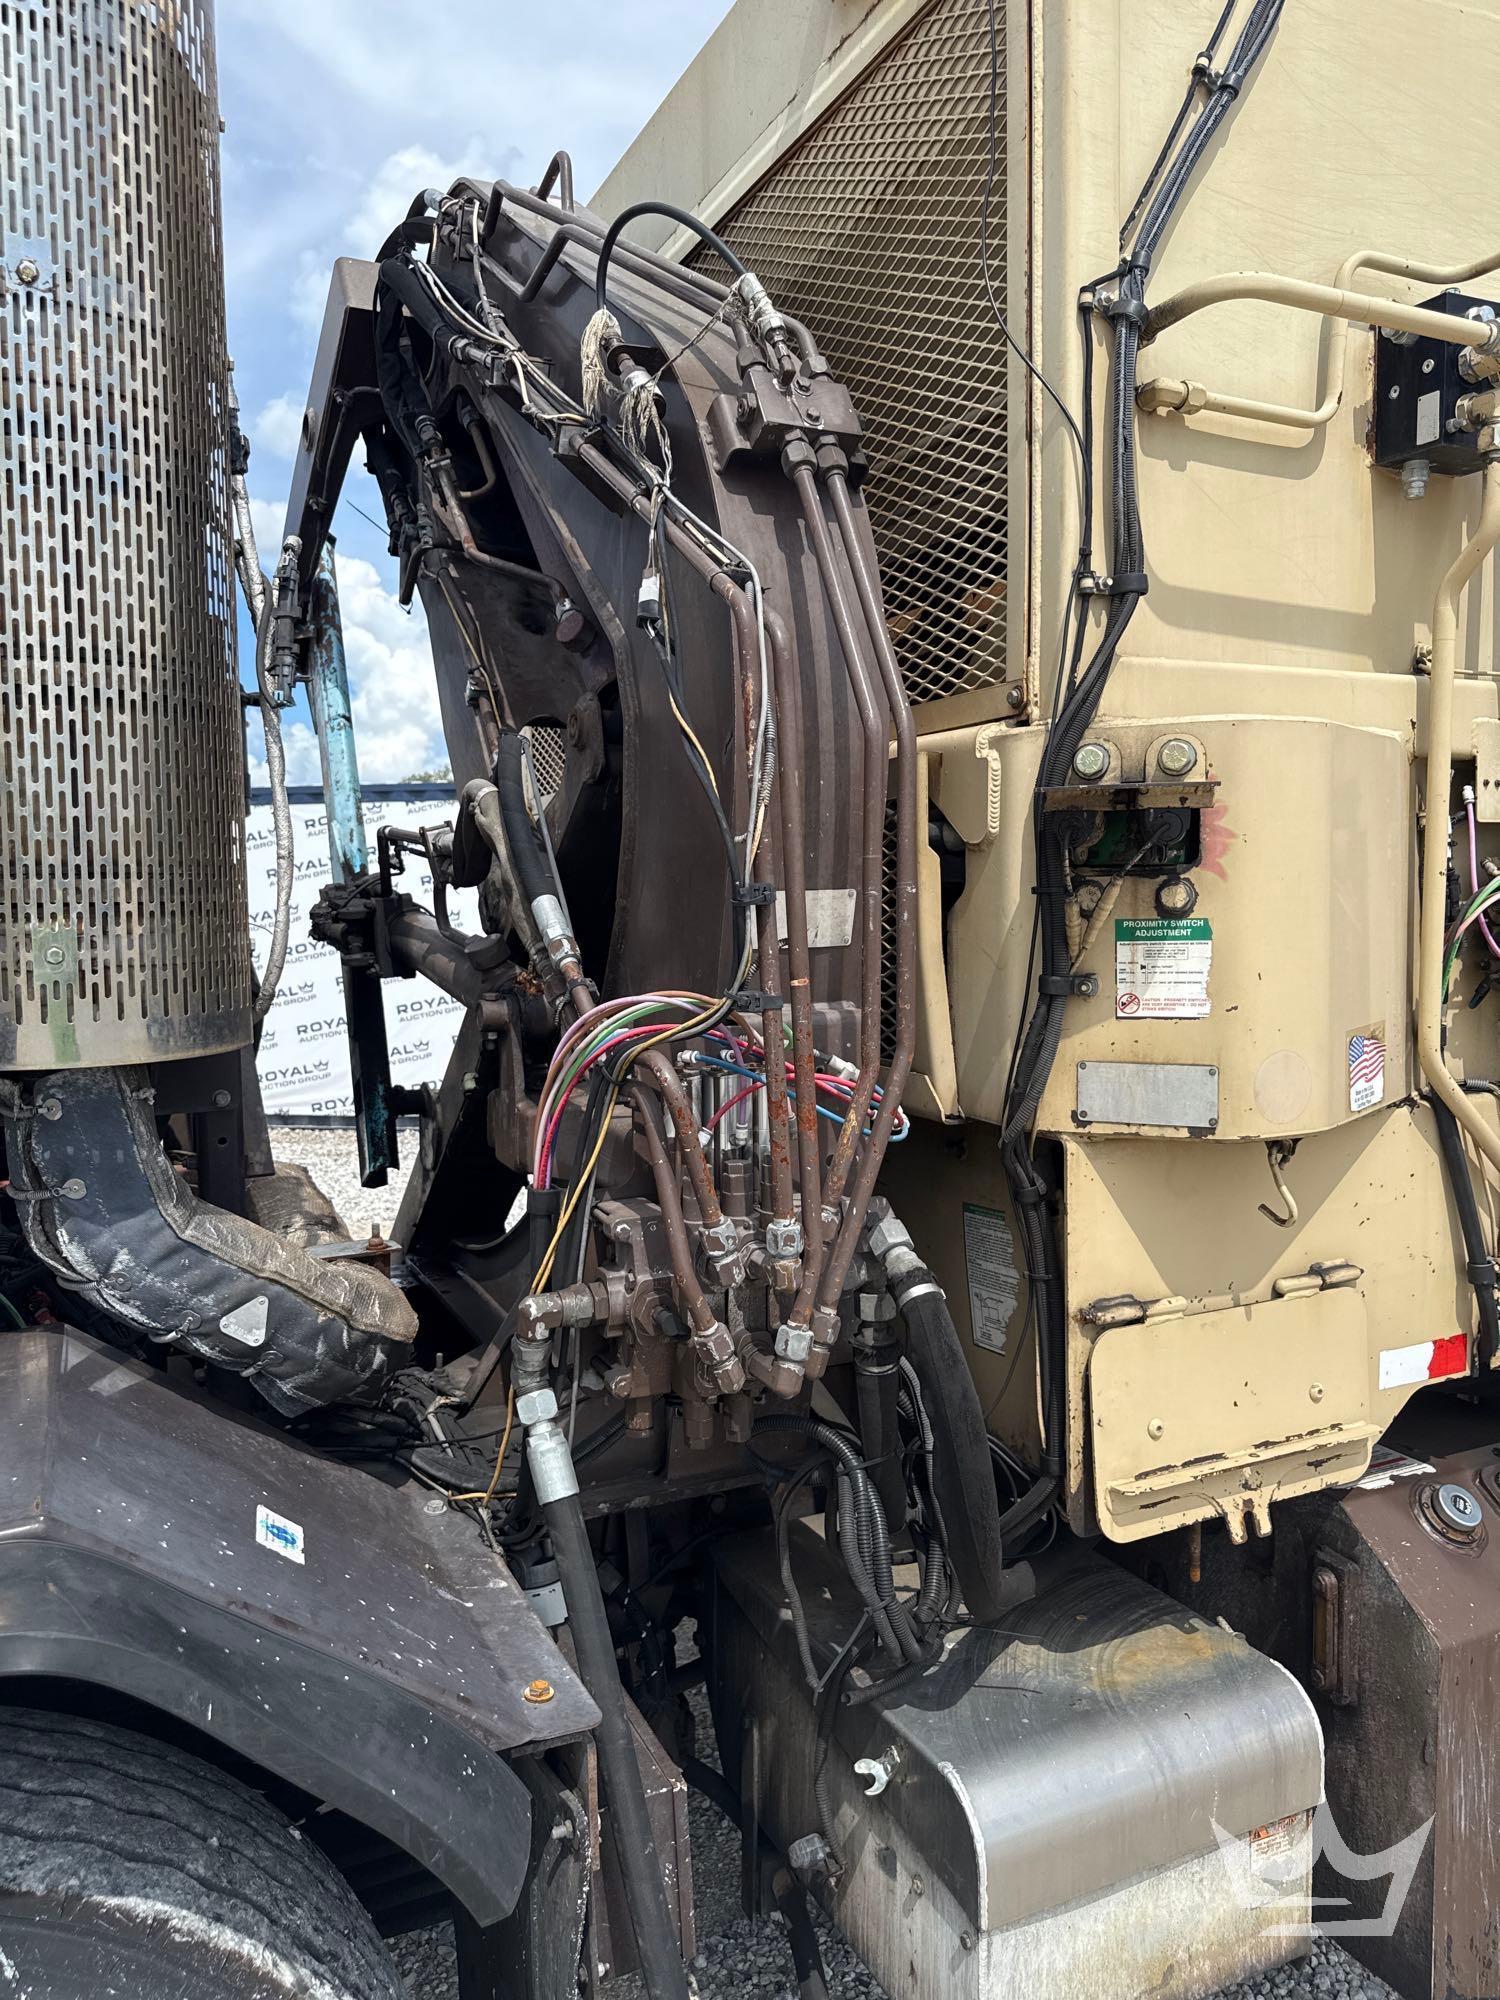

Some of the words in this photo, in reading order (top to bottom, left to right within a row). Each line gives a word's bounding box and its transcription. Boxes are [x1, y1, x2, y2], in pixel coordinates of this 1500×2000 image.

[365, 814, 386, 825] OUP
[266, 857, 329, 880] RYAL
[1123, 920, 1168, 928] PROXIMITY
[1170, 919, 1204, 927] SWITCH
[1135, 928, 1192, 937] ADJUSTMENT
[283, 994, 317, 1007] GROUP
[399, 1008, 443, 1023] AUCTION
[297, 1016, 348, 1036] ROYA
[299, 1030, 341, 1044] AUCTION
[398, 1052, 432, 1065] GROUP
[261, 1079, 297, 1092] UCTION
[298, 1072, 331, 1084] GROUP
[311, 1096, 355, 1113] ROY
